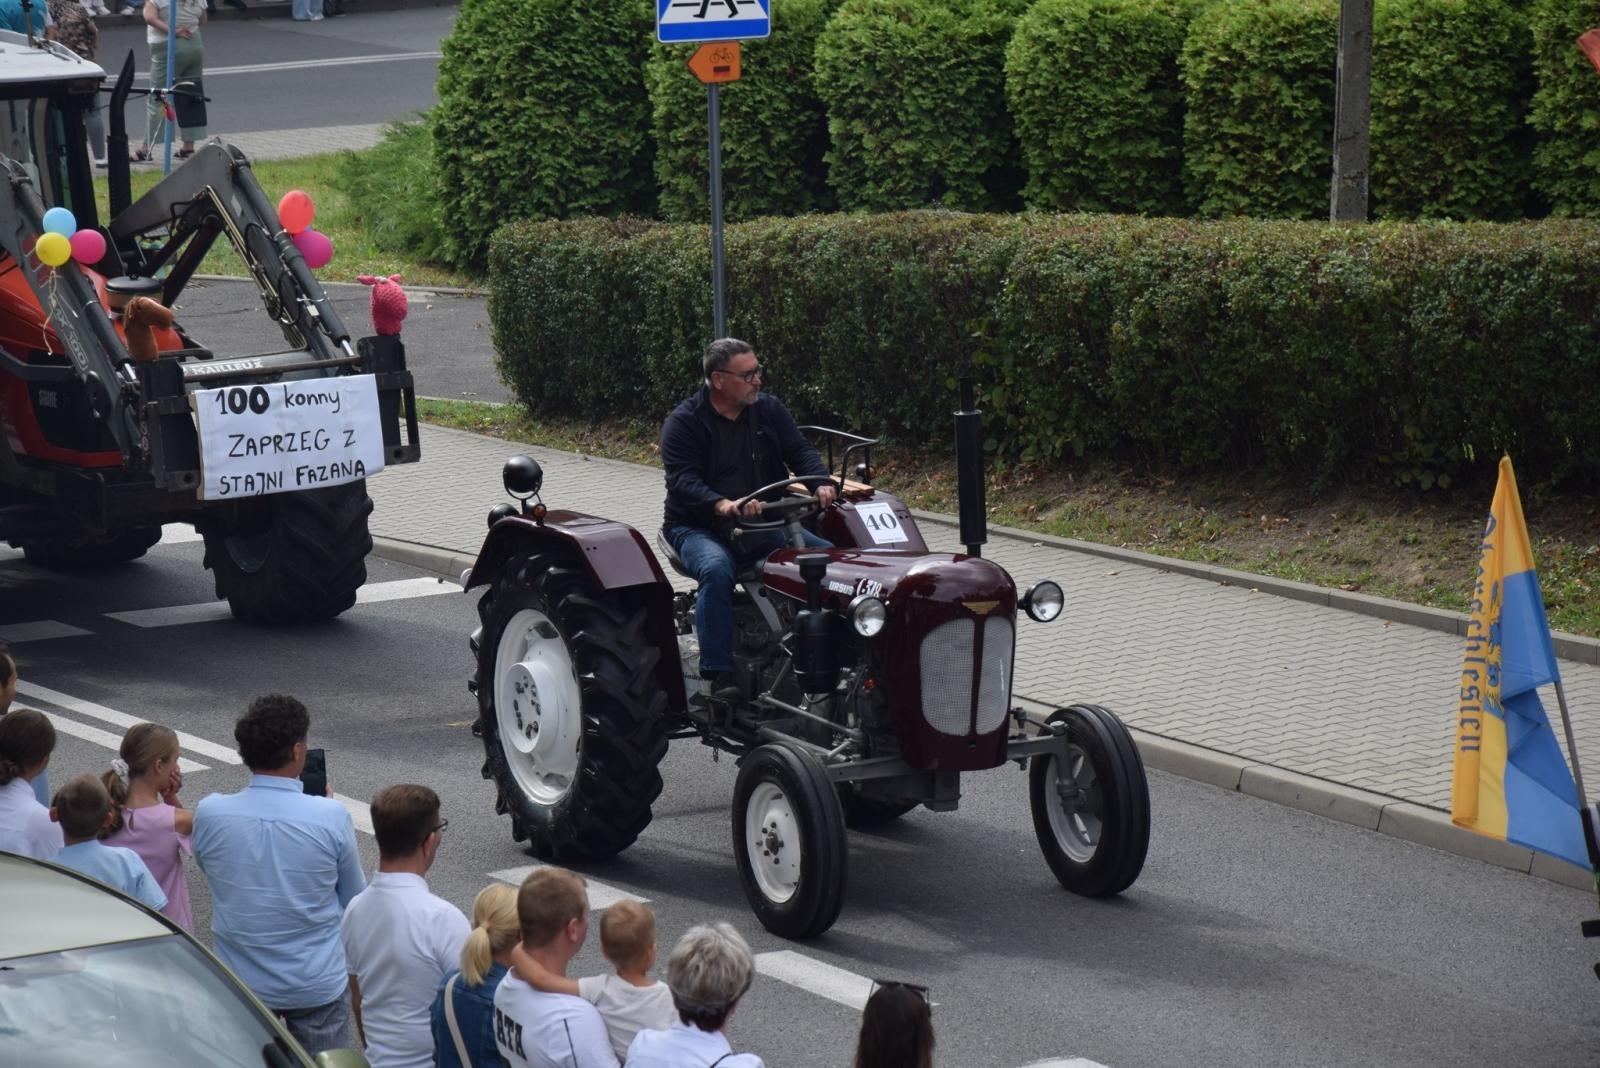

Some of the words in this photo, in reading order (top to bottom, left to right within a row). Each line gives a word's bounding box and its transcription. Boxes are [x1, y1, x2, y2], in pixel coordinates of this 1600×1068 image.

[215, 386, 271, 415] 100
[283, 384, 341, 413] konny
[219, 470, 283, 496] STAJNI
[296, 459, 366, 487] FAZANA
[866, 512, 897, 531] 40
[828, 580, 855, 596] URSUS
[1459, 511, 1497, 753] Oschlesien
[493, 1006, 528, 1062] ATA
